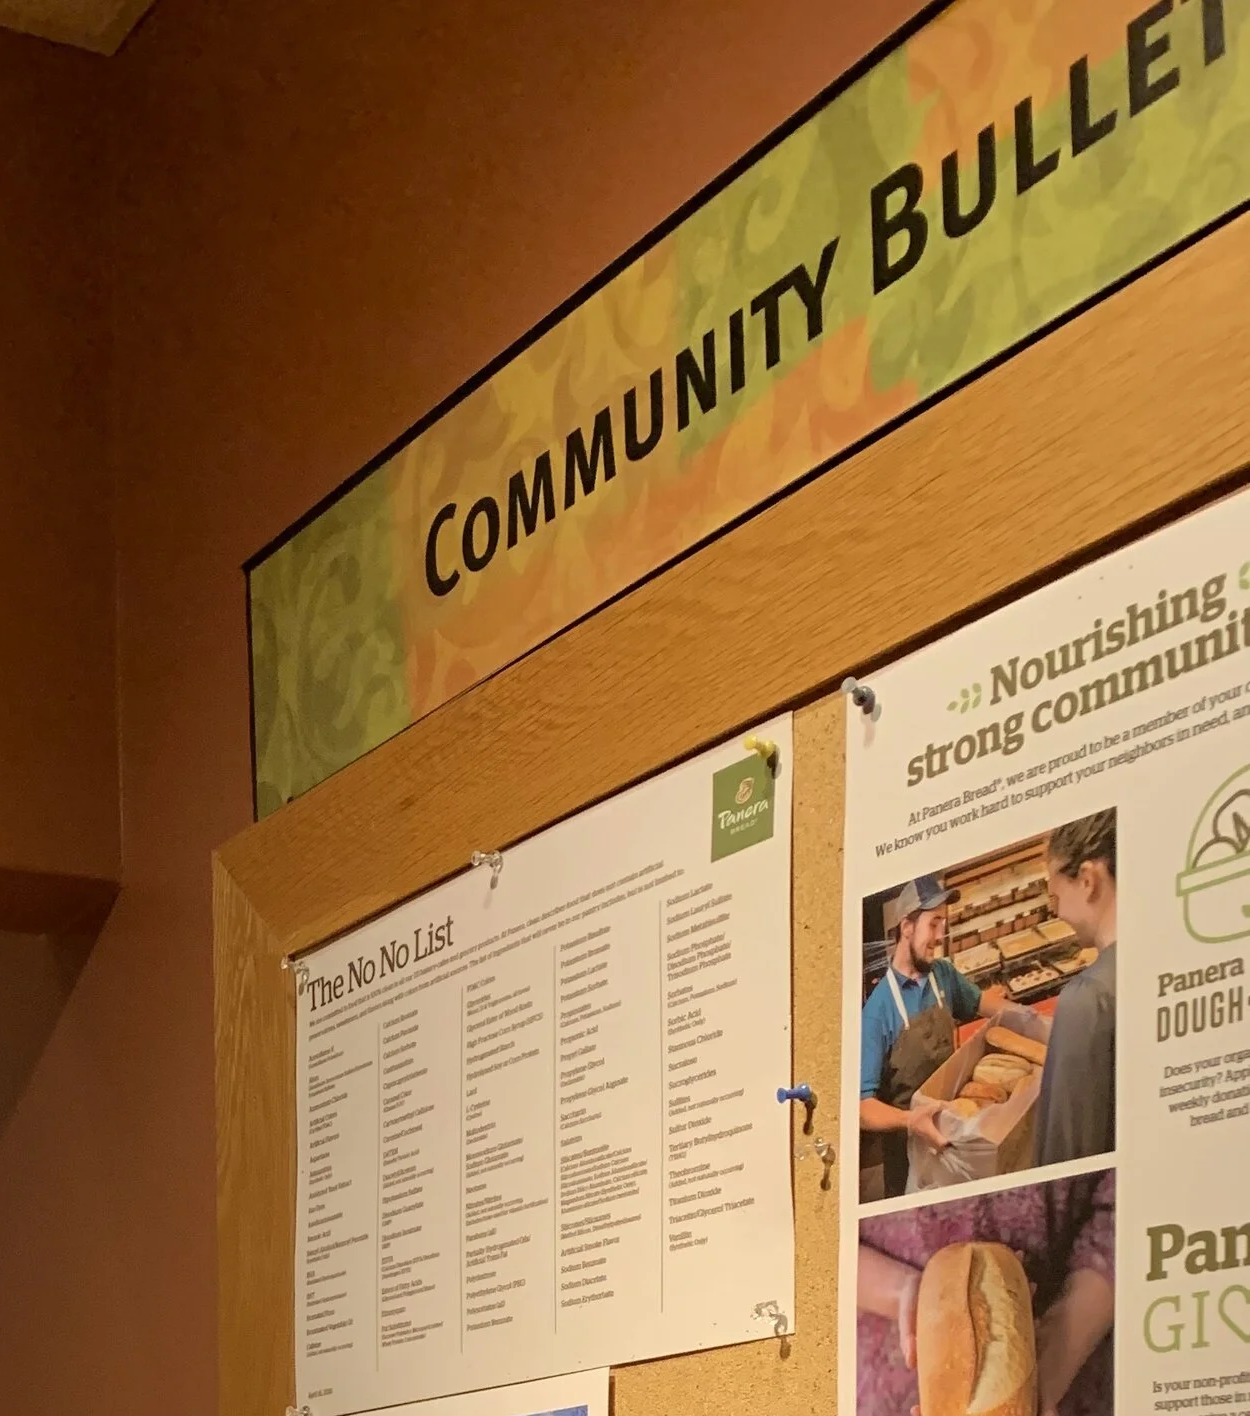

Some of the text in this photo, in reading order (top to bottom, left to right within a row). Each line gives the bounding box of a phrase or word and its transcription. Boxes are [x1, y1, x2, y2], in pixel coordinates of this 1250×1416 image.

[425, 236, 840, 597] COMMUNITY
[989, 573, 1227, 705] Nourishing
[907, 709, 1024, 787] strong
[908, 811, 921, 827] At
[922, 796, 962, 820] Panera
[1005, 771, 1025, 787] we
[1026, 763, 1047, 780] are
[1047, 744, 1087, 774] proud
[1089, 741, 1103, 755] to
[1103, 734, 1121, 749] be
[1122, 730, 1131, 742] a
[1132, 705, 1191, 738] member
[1191, 696, 1207, 714] of
[1208, 684, 1242, 711] your
[875, 842, 893, 858] We
[894, 830, 925, 851] know
[925, 821, 948, 840] you
[948, 808, 979, 829] work
[980, 795, 1009, 818] hard
[1010, 793, 1024, 806] to
[1024, 771, 1073, 801] support
[1075, 759, 1107, 784] your
[1107, 733, 1175, 769] neighbors
[1175, 728, 1191, 743] in
[718, 800, 768, 829] Panera
[307, 974, 344, 1012] The
[348, 956, 375, 994] No
[379, 940, 409, 978] No
[414, 916, 455, 963] List
[1158, 957, 1244, 998] Panera
[1164, 1063, 1193, 1079] Does
[1193, 1056, 1222, 1073] your
[1168, 1095, 1211, 1113] weekly
[1189, 1108, 1225, 1127] bread
[1152, 1381, 1163, 1393] Is
[1163, 1380, 1192, 1393] your
[1154, 1396, 1199, 1412] support
[1199, 1394, 1233, 1406] those
